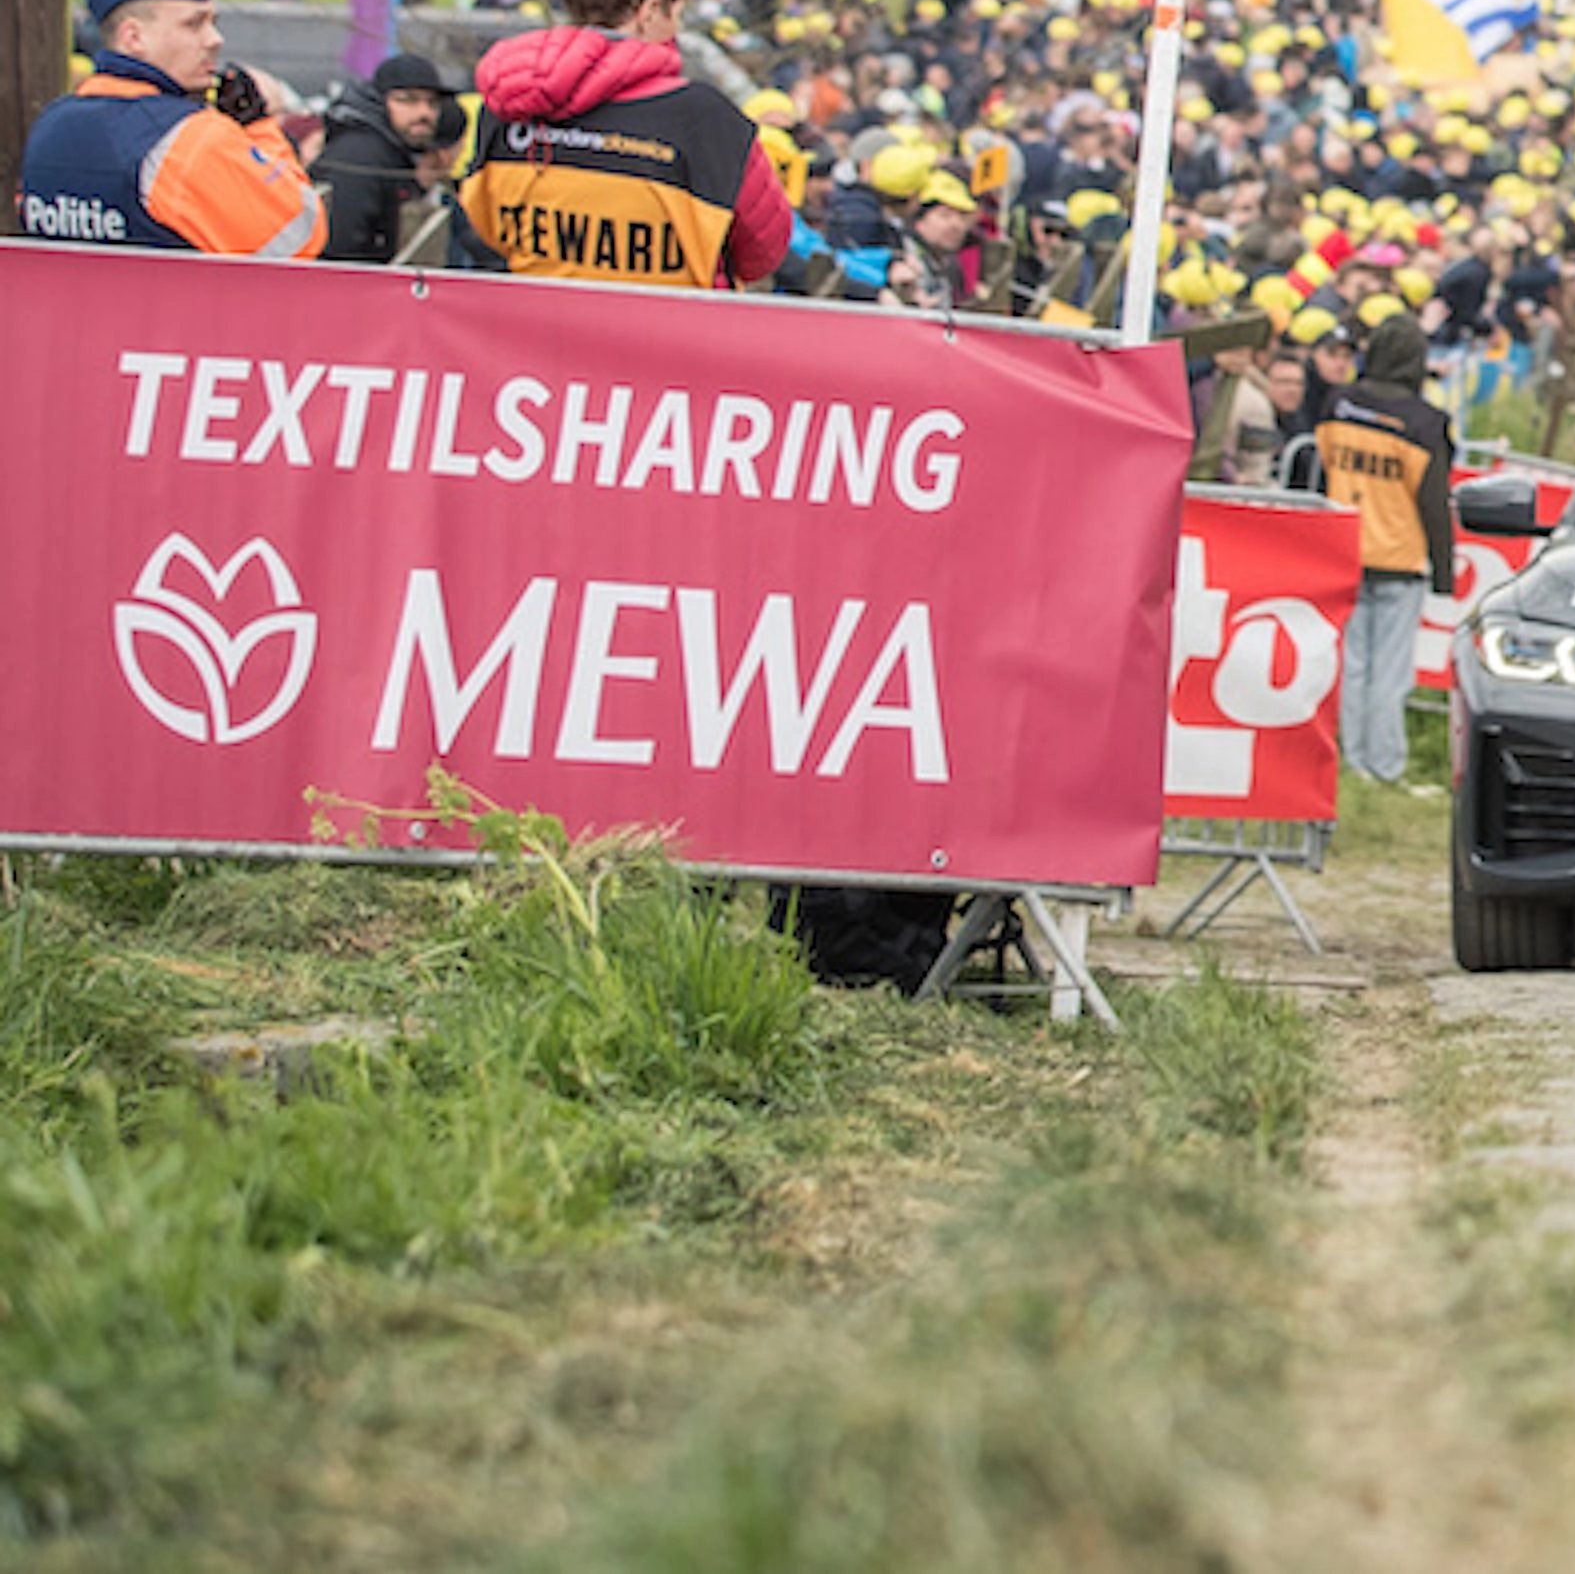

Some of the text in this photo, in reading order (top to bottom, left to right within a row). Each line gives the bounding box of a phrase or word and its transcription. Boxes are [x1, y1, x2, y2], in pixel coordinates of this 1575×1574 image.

[26, 195, 126, 240] Politie
[117, 351, 966, 514] TEXTILSHARING
[371, 567, 950, 784] MEWA
